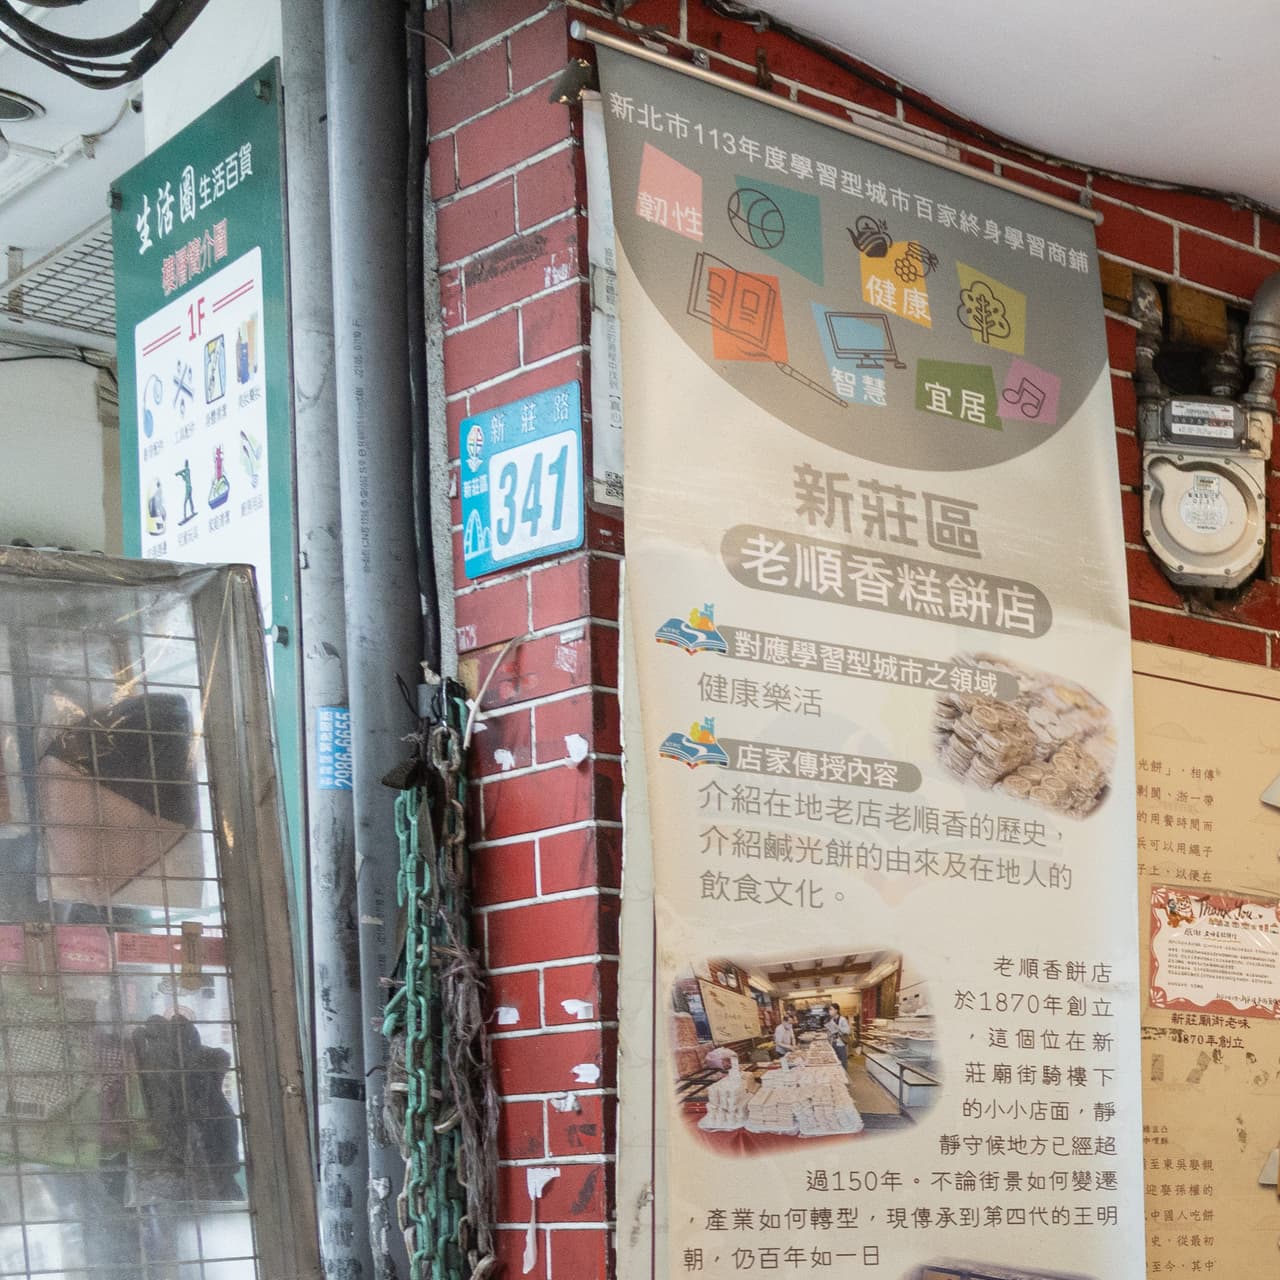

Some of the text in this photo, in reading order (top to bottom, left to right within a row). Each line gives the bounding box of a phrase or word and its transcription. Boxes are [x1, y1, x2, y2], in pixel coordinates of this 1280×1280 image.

[199, 142, 253, 210] 生活百貨
[608, 91, 1089, 275] 新北市113年度學習型城市百家終身學習商鋪
[637, 190, 704, 238] 韌性
[187, 295, 206, 342] 1F
[866, 274, 931, 323] 健康
[830, 366, 888, 406] 智慧
[925, 382, 987, 425] 宜居
[490, 391, 569, 444] 新莊路
[496, 444, 569, 546] 341
[793, 461, 983, 559] 新莊區
[740, 534, 1038, 636] 老順香糕餅店
[735, 629, 999, 699] 對應學習型城市之領域
[697, 671, 823, 719] 健康樂活
[736, 744, 899, 788] 店家傳授內容
[697, 782, 1065, 847] 介紹在地老店老順香的歷史，
[699, 825, 1073, 891] 介紹鹹光餅的由來及在地人的
[699, 870, 847, 909] 飲食文化。
[993, 954, 1113, 986] 老順香餅店
[954, 989, 1114, 1019] 於1870年創立
[964, 1061, 1115, 1088] 莊廟街騎樓下
[962, 1096, 1116, 1124] 的小小店面，靜
[938, 1132, 1117, 1158] 靜守候地方已經超
[1143, 1158, 1214, 1171] 至東吳娶親
[805, 1167, 1119, 1194] 過150年。不論街景如何變遷
[1145, 1209, 1214, 1222] 中國人吃餅
[683, 1242, 882, 1273] 朝，仍百年如一日
[1146, 1260, 1214, 1273] 至今，其中
